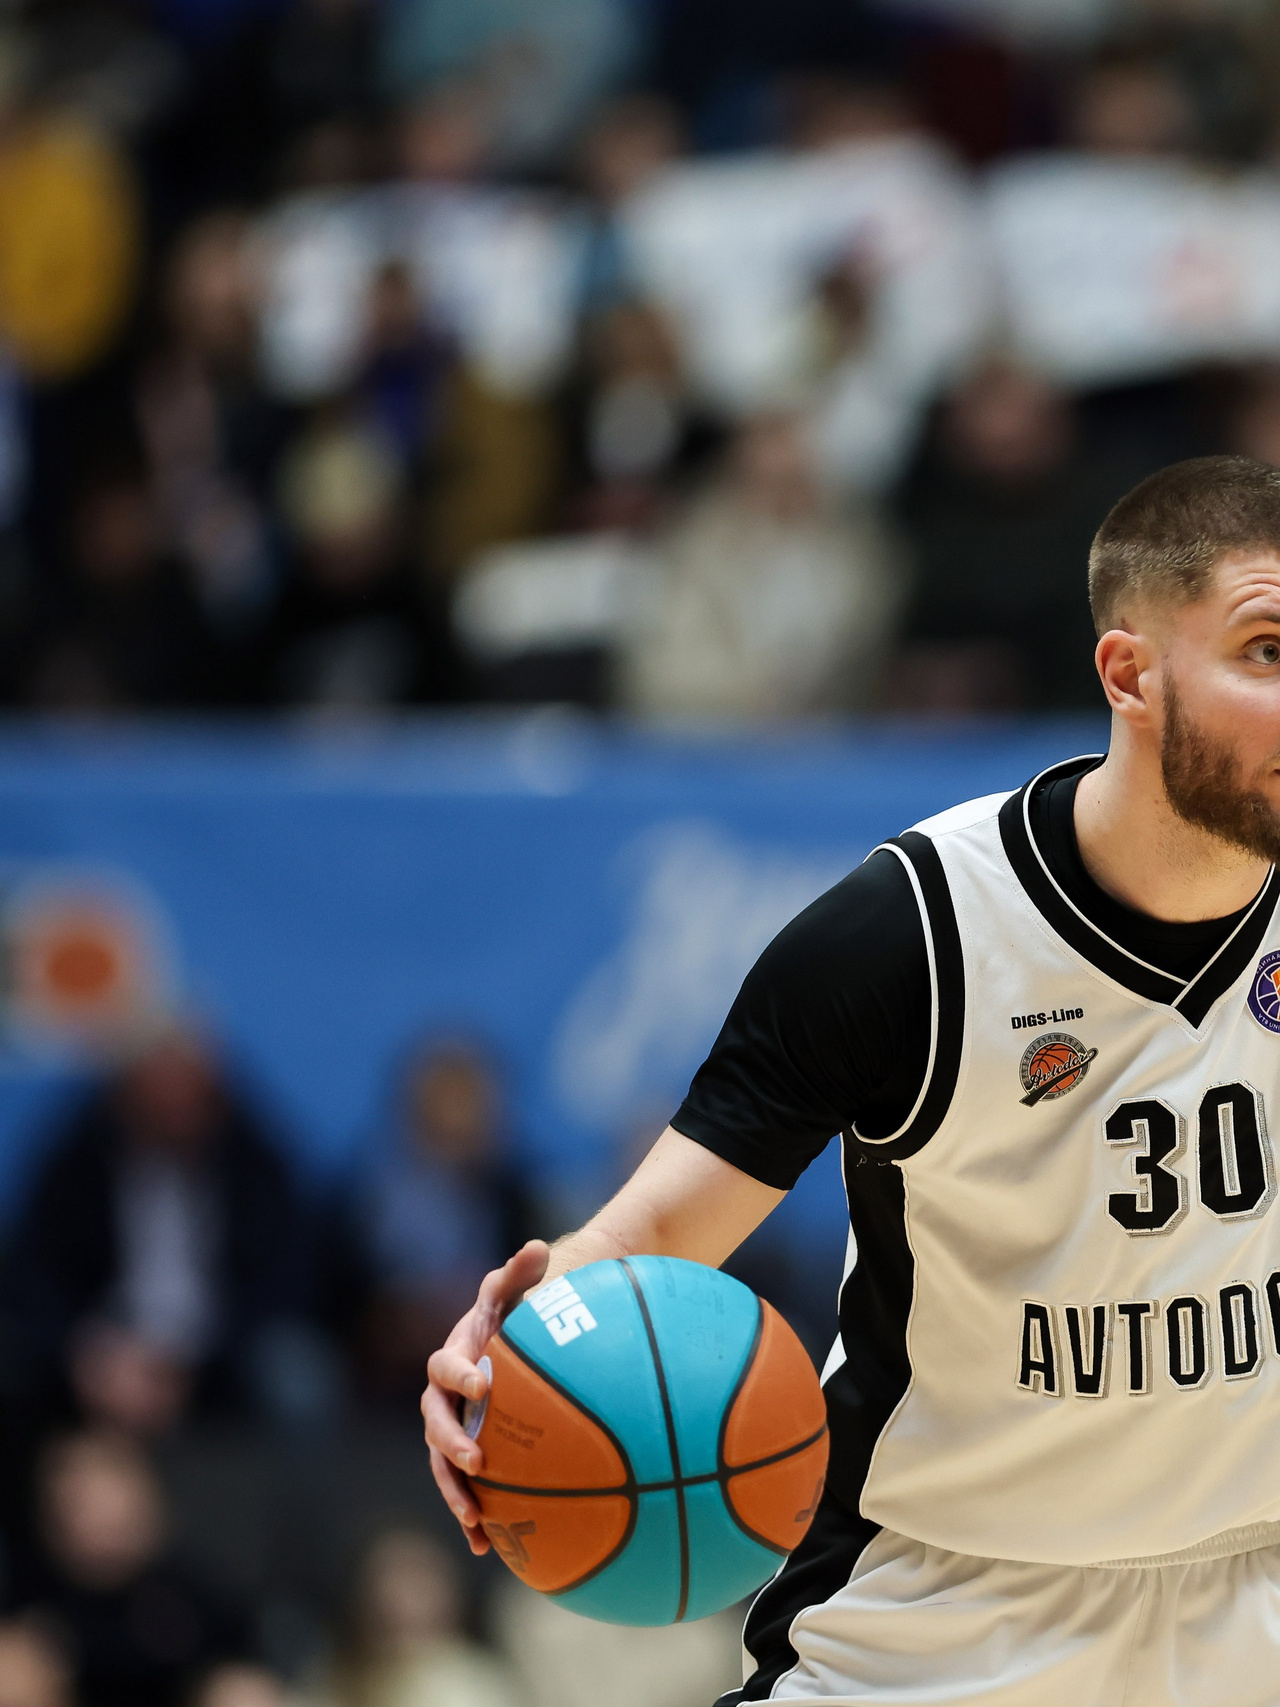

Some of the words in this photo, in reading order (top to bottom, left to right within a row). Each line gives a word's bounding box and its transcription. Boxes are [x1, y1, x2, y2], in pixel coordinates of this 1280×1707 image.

[1011, 1007, 1084, 1029] DIGS-Line
[1258, 1013, 1269, 1025] VTB
[1029, 1051, 1088, 1087] Avtodor
[1101, 1078, 1278, 1238] 30
